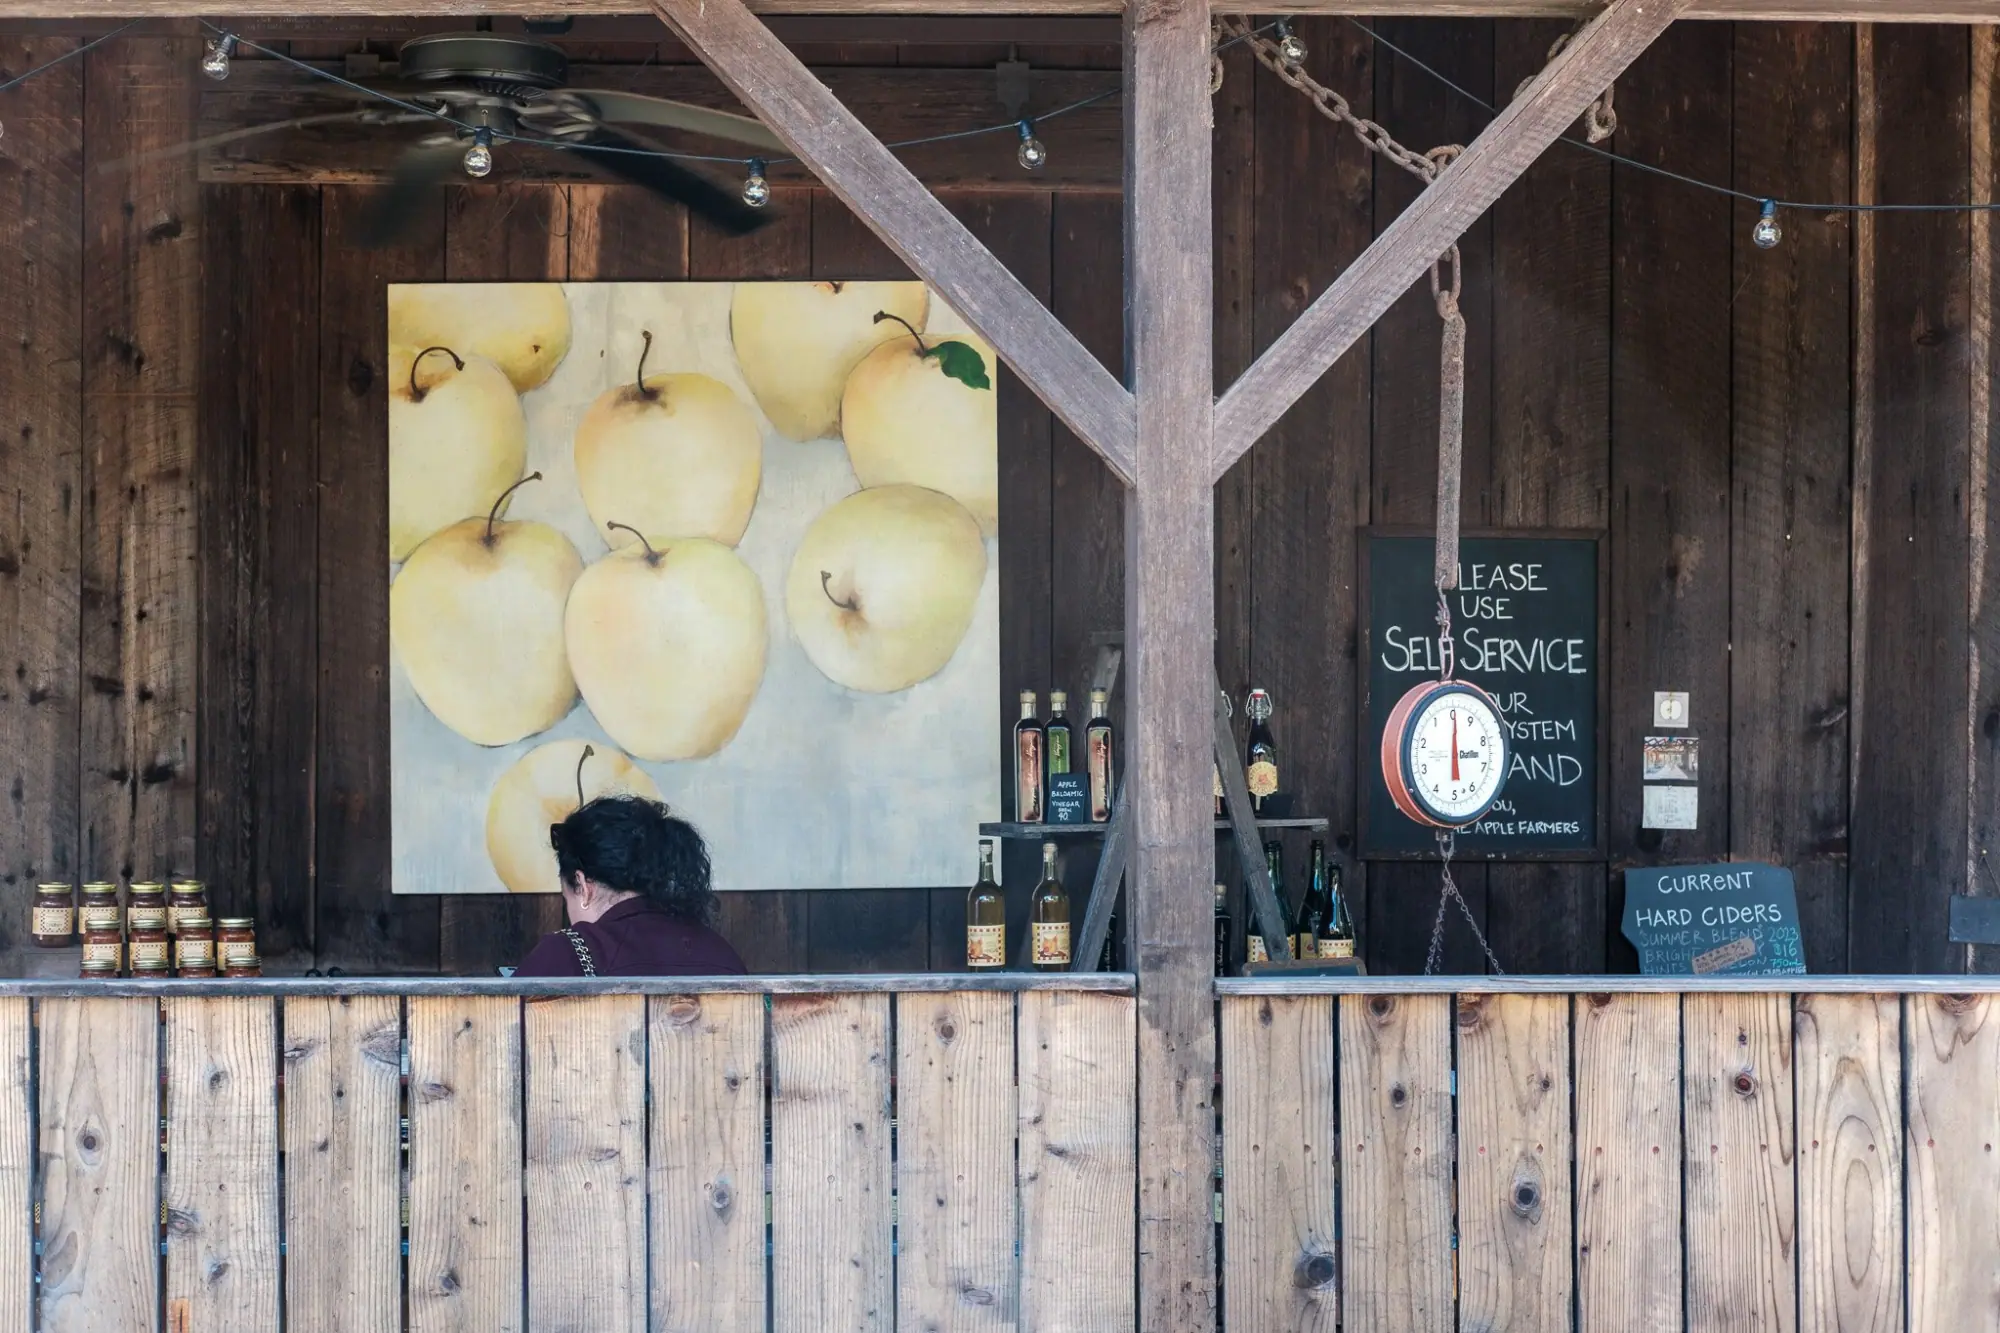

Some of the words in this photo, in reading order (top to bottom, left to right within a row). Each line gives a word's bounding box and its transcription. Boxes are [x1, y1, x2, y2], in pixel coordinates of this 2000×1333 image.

[1458, 563, 1547, 591] LEASE
[1461, 596, 1513, 619] USE
[1460, 628, 1586, 673] SERVICE
[1467, 716, 1474, 727] 9
[1503, 719, 1576, 741] YSTEM
[1420, 738, 1426, 749] 2
[1480, 735, 1486, 746] 8
[1421, 764, 1427, 774] 3
[1481, 762, 1487, 773] 7
[1508, 753, 1582, 786] AND
[1433, 784, 1439, 793] 4
[1469, 781, 1475, 792] 6
[1451, 790, 1457, 801] 5
[1051, 800, 1080, 808] VINEGAR
[1491, 799, 1516, 815] OU,
[1474, 821, 1514, 835] APPLE
[1518, 820, 1580, 835] FARMERS
[1636, 908, 1692, 928] HARD
